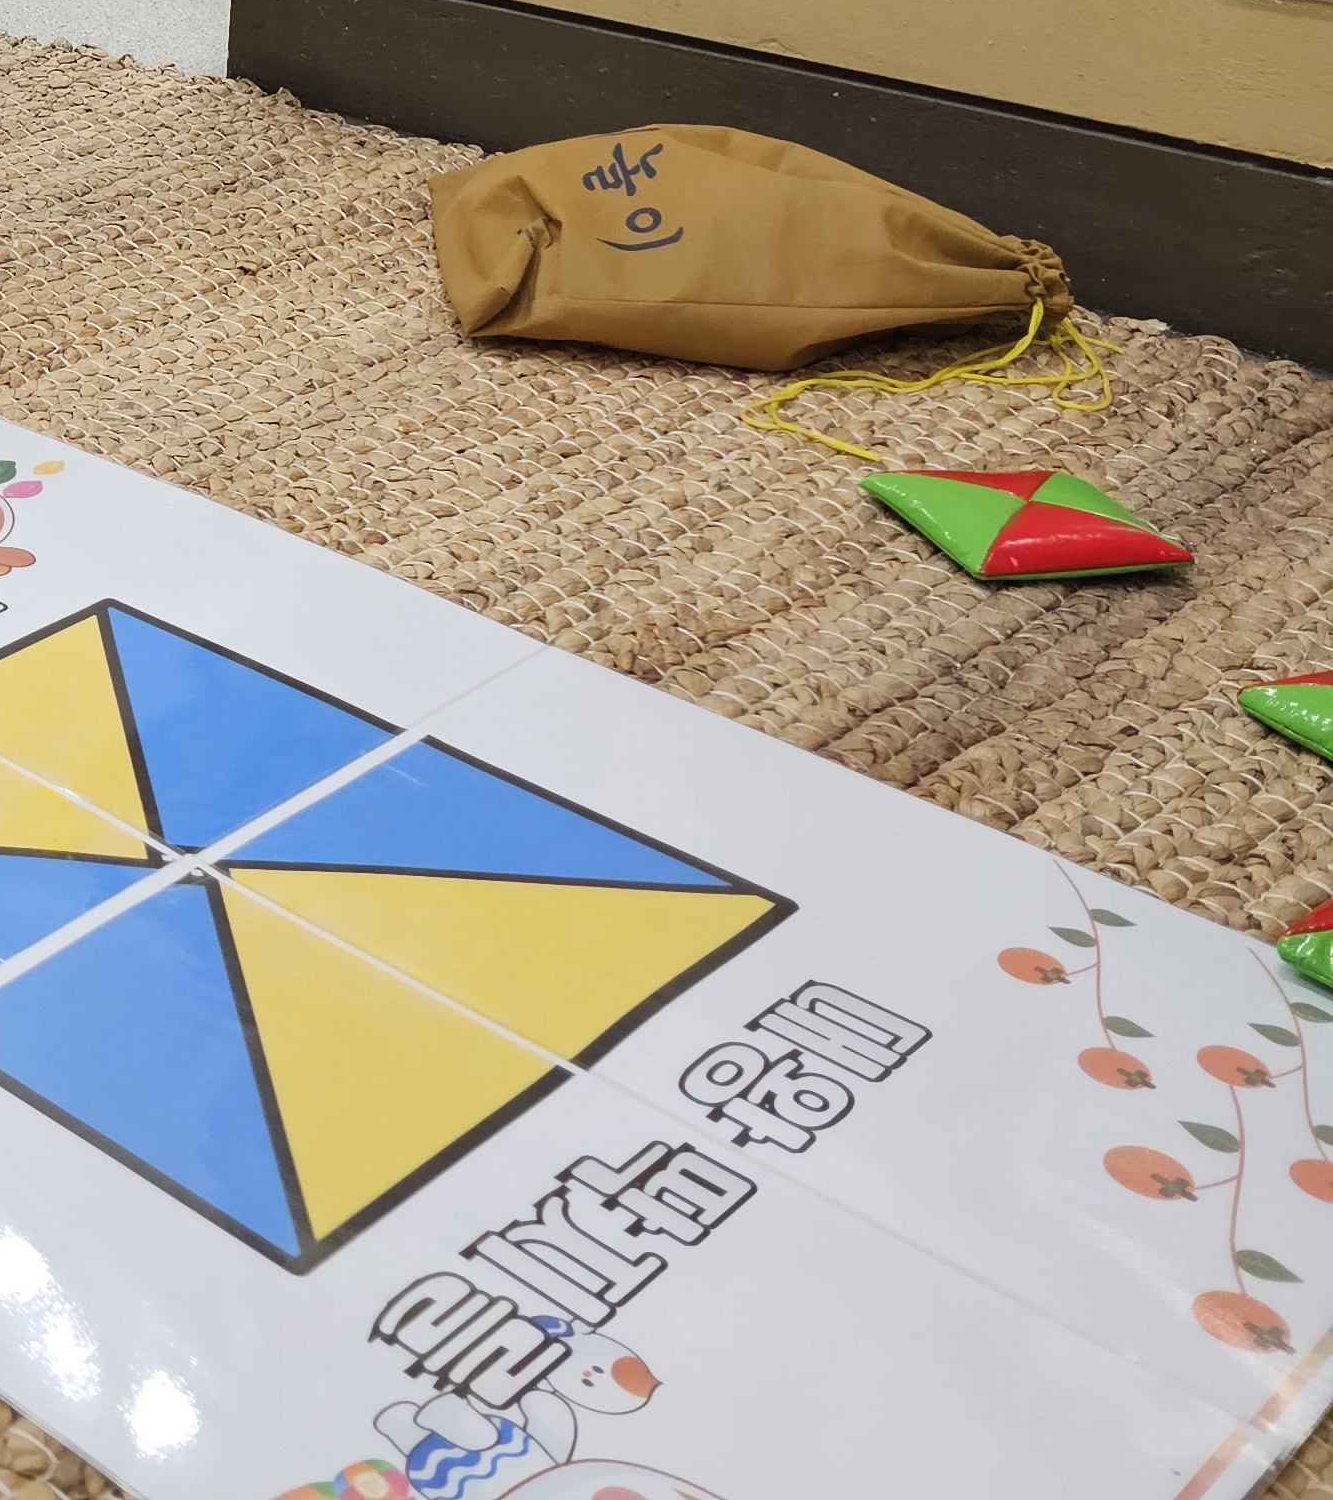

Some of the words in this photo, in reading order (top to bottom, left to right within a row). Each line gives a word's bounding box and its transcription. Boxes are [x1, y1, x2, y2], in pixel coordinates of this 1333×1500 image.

[582, 141, 685, 252] 놀이
[678, 979, 933, 1153] 대왕
[368, 1138, 759, 1411] 딱지를
